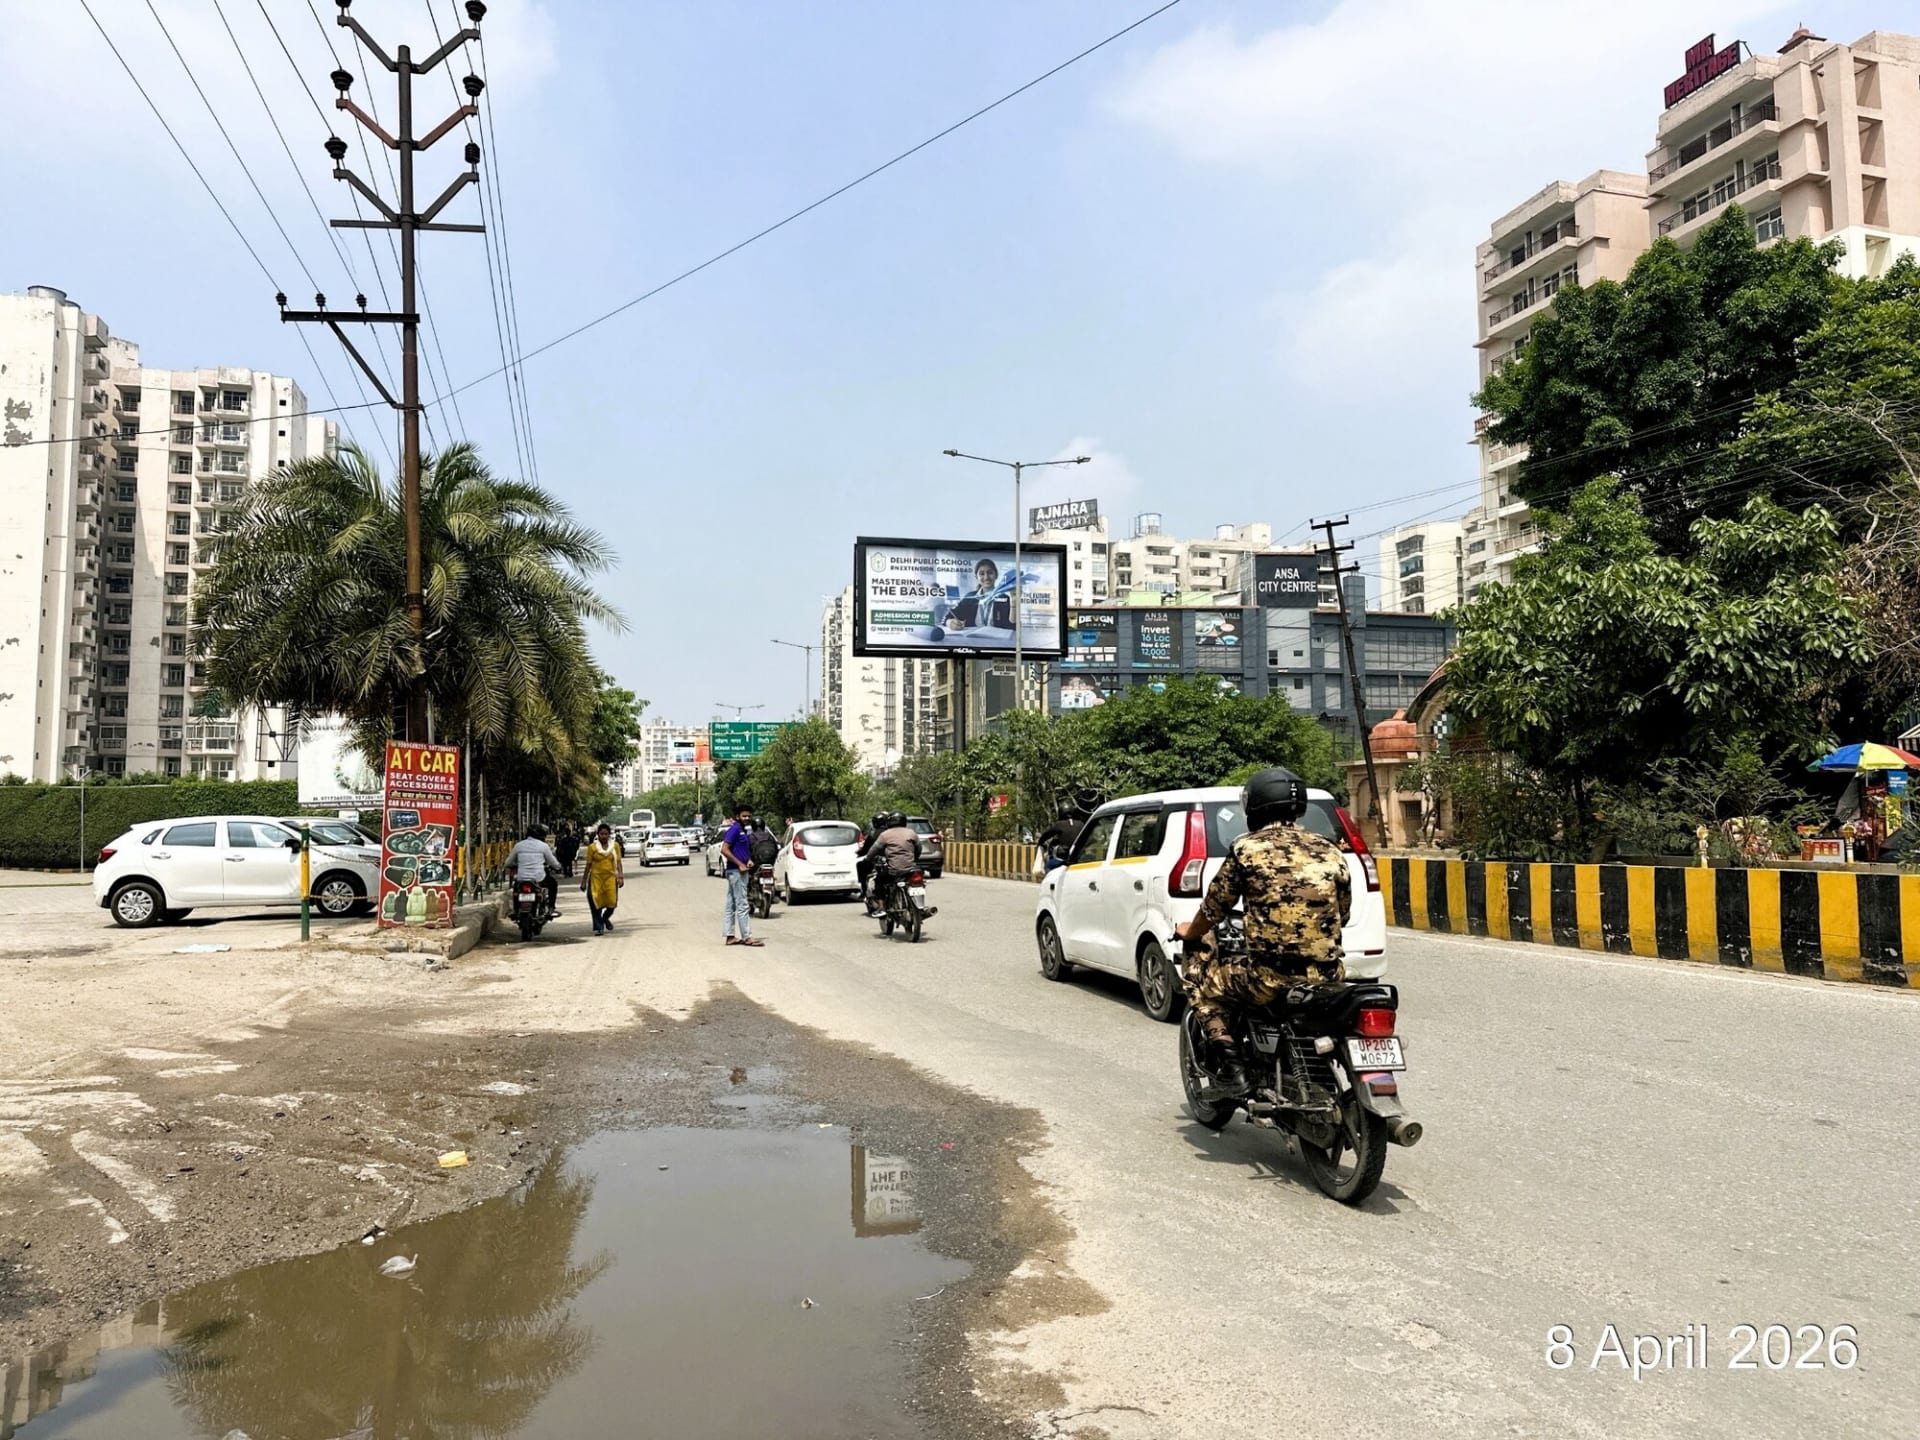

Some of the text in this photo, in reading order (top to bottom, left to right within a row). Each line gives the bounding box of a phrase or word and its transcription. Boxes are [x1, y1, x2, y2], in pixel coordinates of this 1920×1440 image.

[1665, 43, 1738, 106] HERITAGE
[1036, 501, 1088, 520] AJNARA
[1036, 514, 1090, 530] INTEGRITY
[1274, 567, 1300, 580] ANSA
[871, 578, 922, 586] MASTERING
[1258, 580, 1317, 592] CITY CENTRE
[871, 586, 946, 597] THE BASICS
[1141, 624, 1170, 634] Invest
[1142, 633, 1170, 642] 16 Lac
[390, 748, 456, 774] A1 CAR
[390, 772, 414, 780] SEAT
[416, 774, 446, 783] COVER
[389, 781, 455, 791] ACCESSORIES
[1357, 1039, 1394, 1052] UP20C
